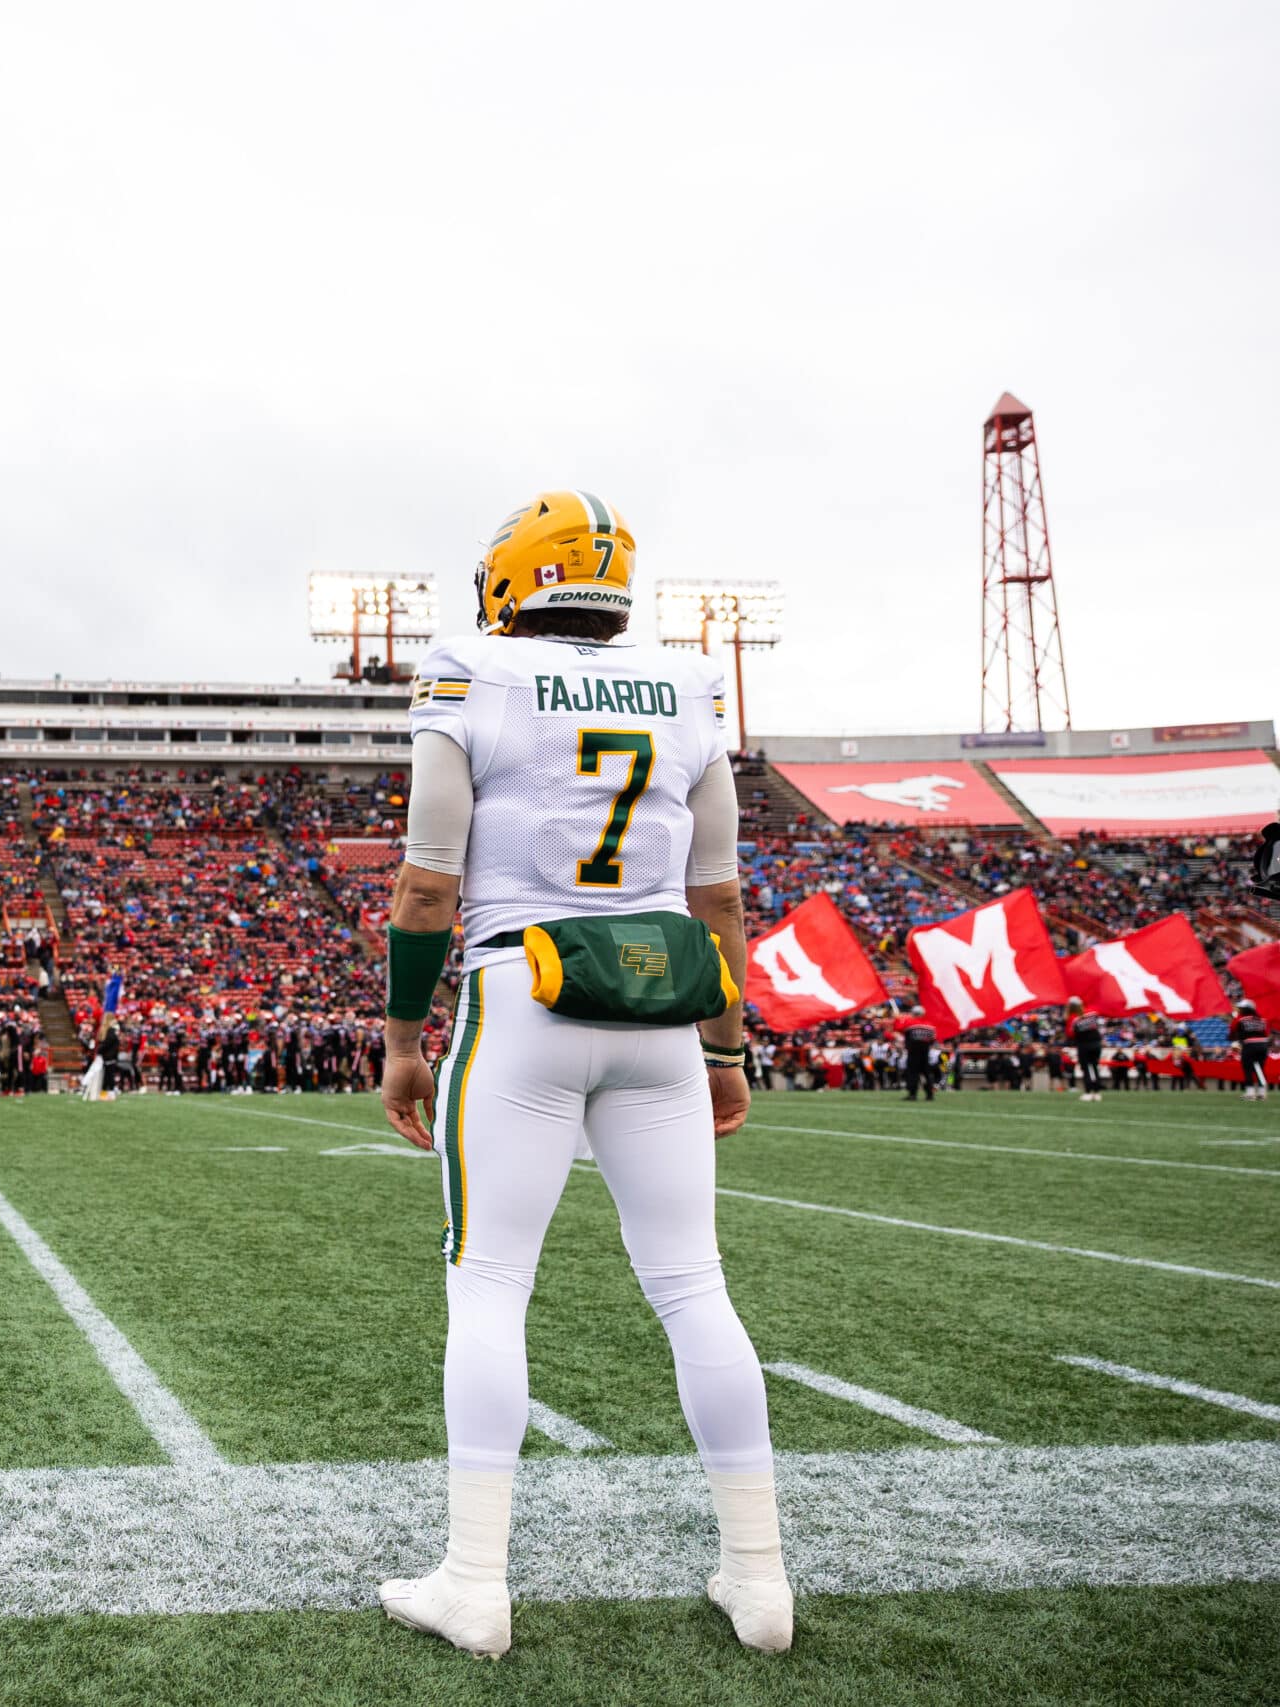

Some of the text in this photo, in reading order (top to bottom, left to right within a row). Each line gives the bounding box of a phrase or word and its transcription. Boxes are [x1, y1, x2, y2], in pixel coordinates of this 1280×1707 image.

[592, 537, 616, 580] 7
[547, 591, 633, 608] EDMONTON
[535, 675, 677, 717] FAJARDO
[575, 728, 656, 887] 7
